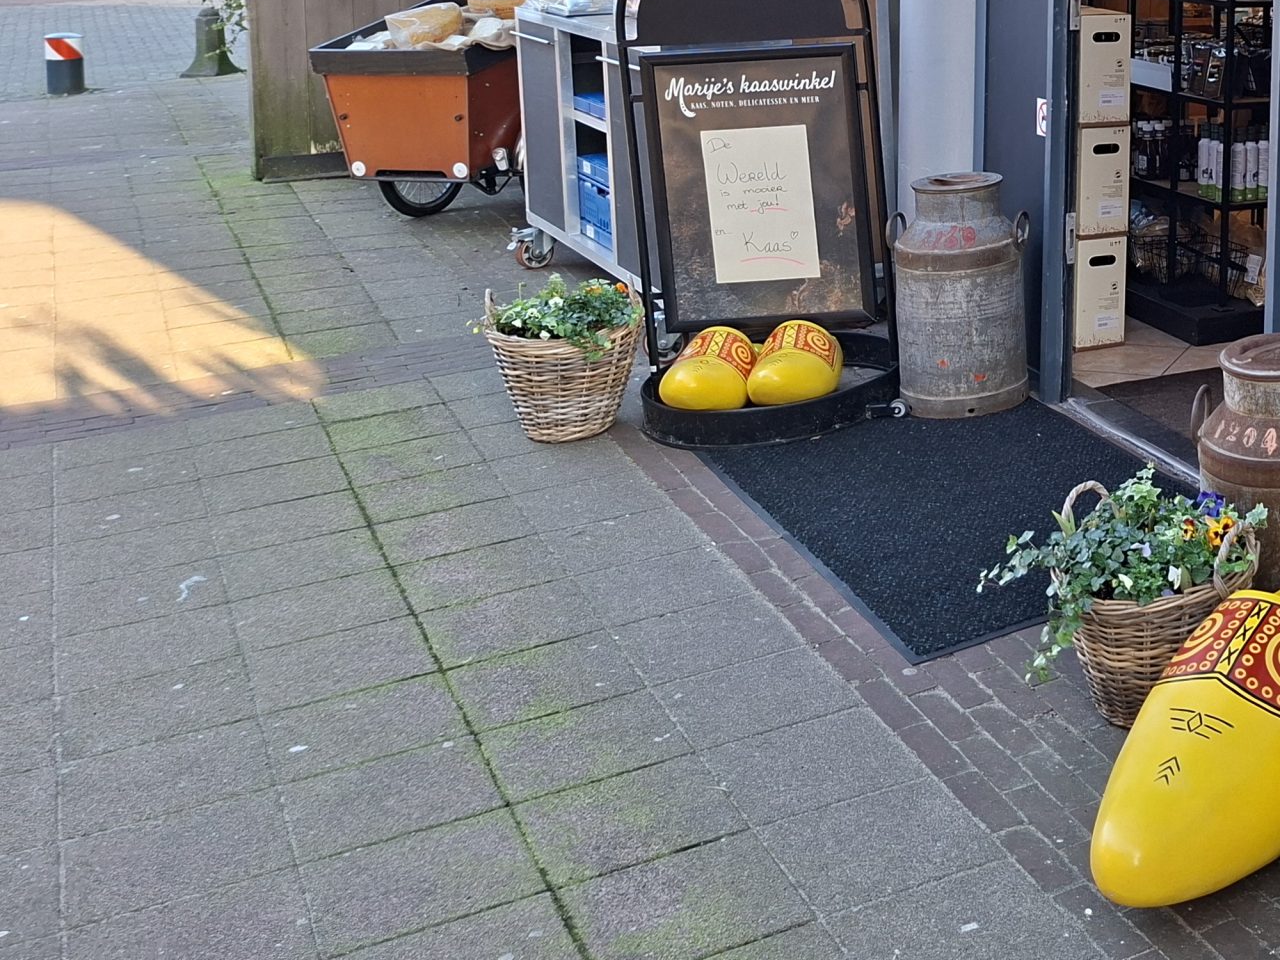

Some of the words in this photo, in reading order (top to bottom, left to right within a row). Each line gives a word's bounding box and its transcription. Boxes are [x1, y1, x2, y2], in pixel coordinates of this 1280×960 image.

[665, 77, 734, 118] Marije's
[740, 70, 836, 94] kaaswinkel
[738, 97, 788, 108] DELICATESSEN
[790, 97, 799, 105] EN
[801, 95, 820, 104] MEER
[706, 137, 732, 153] De
[716, 162, 787, 185] Wereld
[720, 189, 730, 197] is
[743, 185, 787, 195] mooier
[727, 200, 748, 211] met
[757, 195, 780, 214] jou!
[742, 231, 793, 253] Kaas
